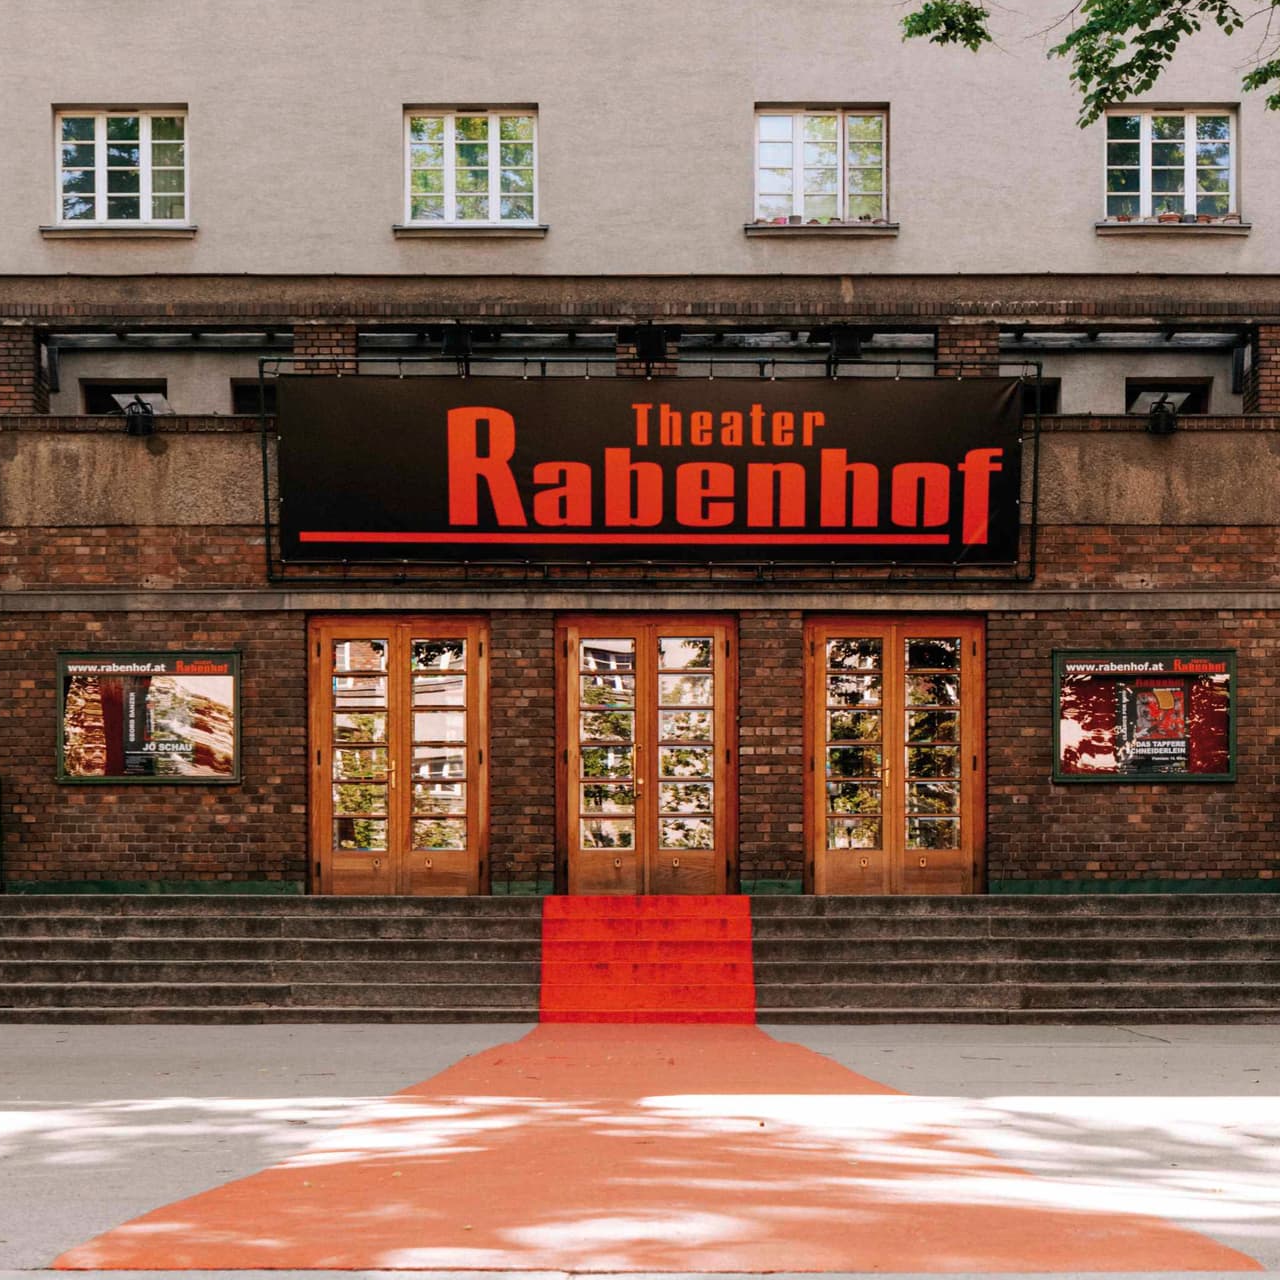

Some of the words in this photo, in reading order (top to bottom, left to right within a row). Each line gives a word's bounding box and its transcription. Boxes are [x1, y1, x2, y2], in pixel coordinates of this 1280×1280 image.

[632, 403, 825, 446] Theater
[447, 406, 1004, 545] Rabenhof
[67, 662, 166, 673] www.rabenhof.at
[1065, 661, 1164, 672] www.rabenhof.at
[158, 743, 193, 751] SCHAU
[1136, 740, 1151, 748] DAS
[1152, 740, 1186, 748] TAPFERE
